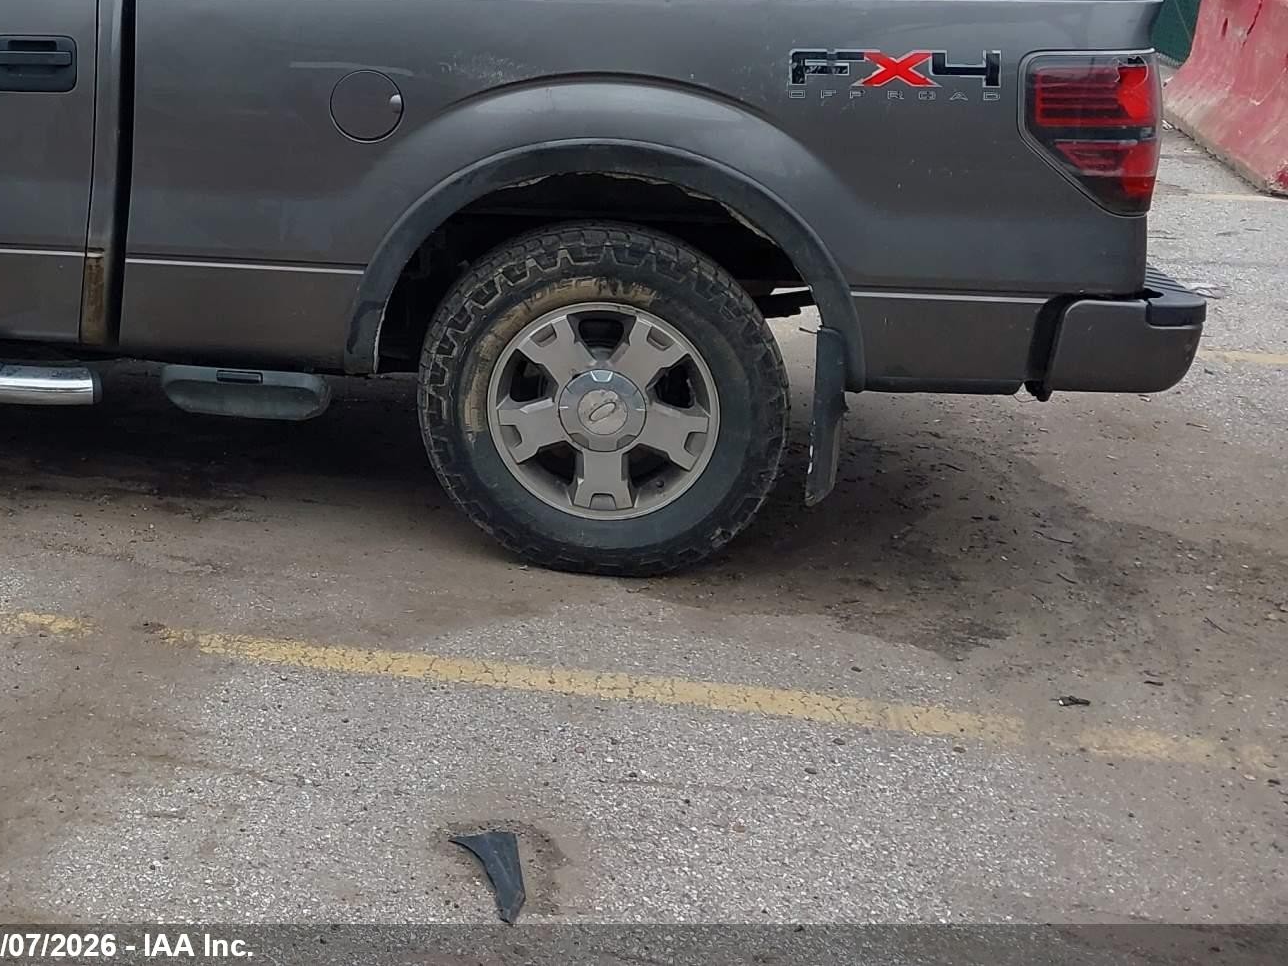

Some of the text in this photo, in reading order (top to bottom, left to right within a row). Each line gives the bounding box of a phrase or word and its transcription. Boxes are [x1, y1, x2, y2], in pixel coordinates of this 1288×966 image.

[789, 49, 1001, 87] FX4
[789, 90, 1001, 100] OFF ROAD
